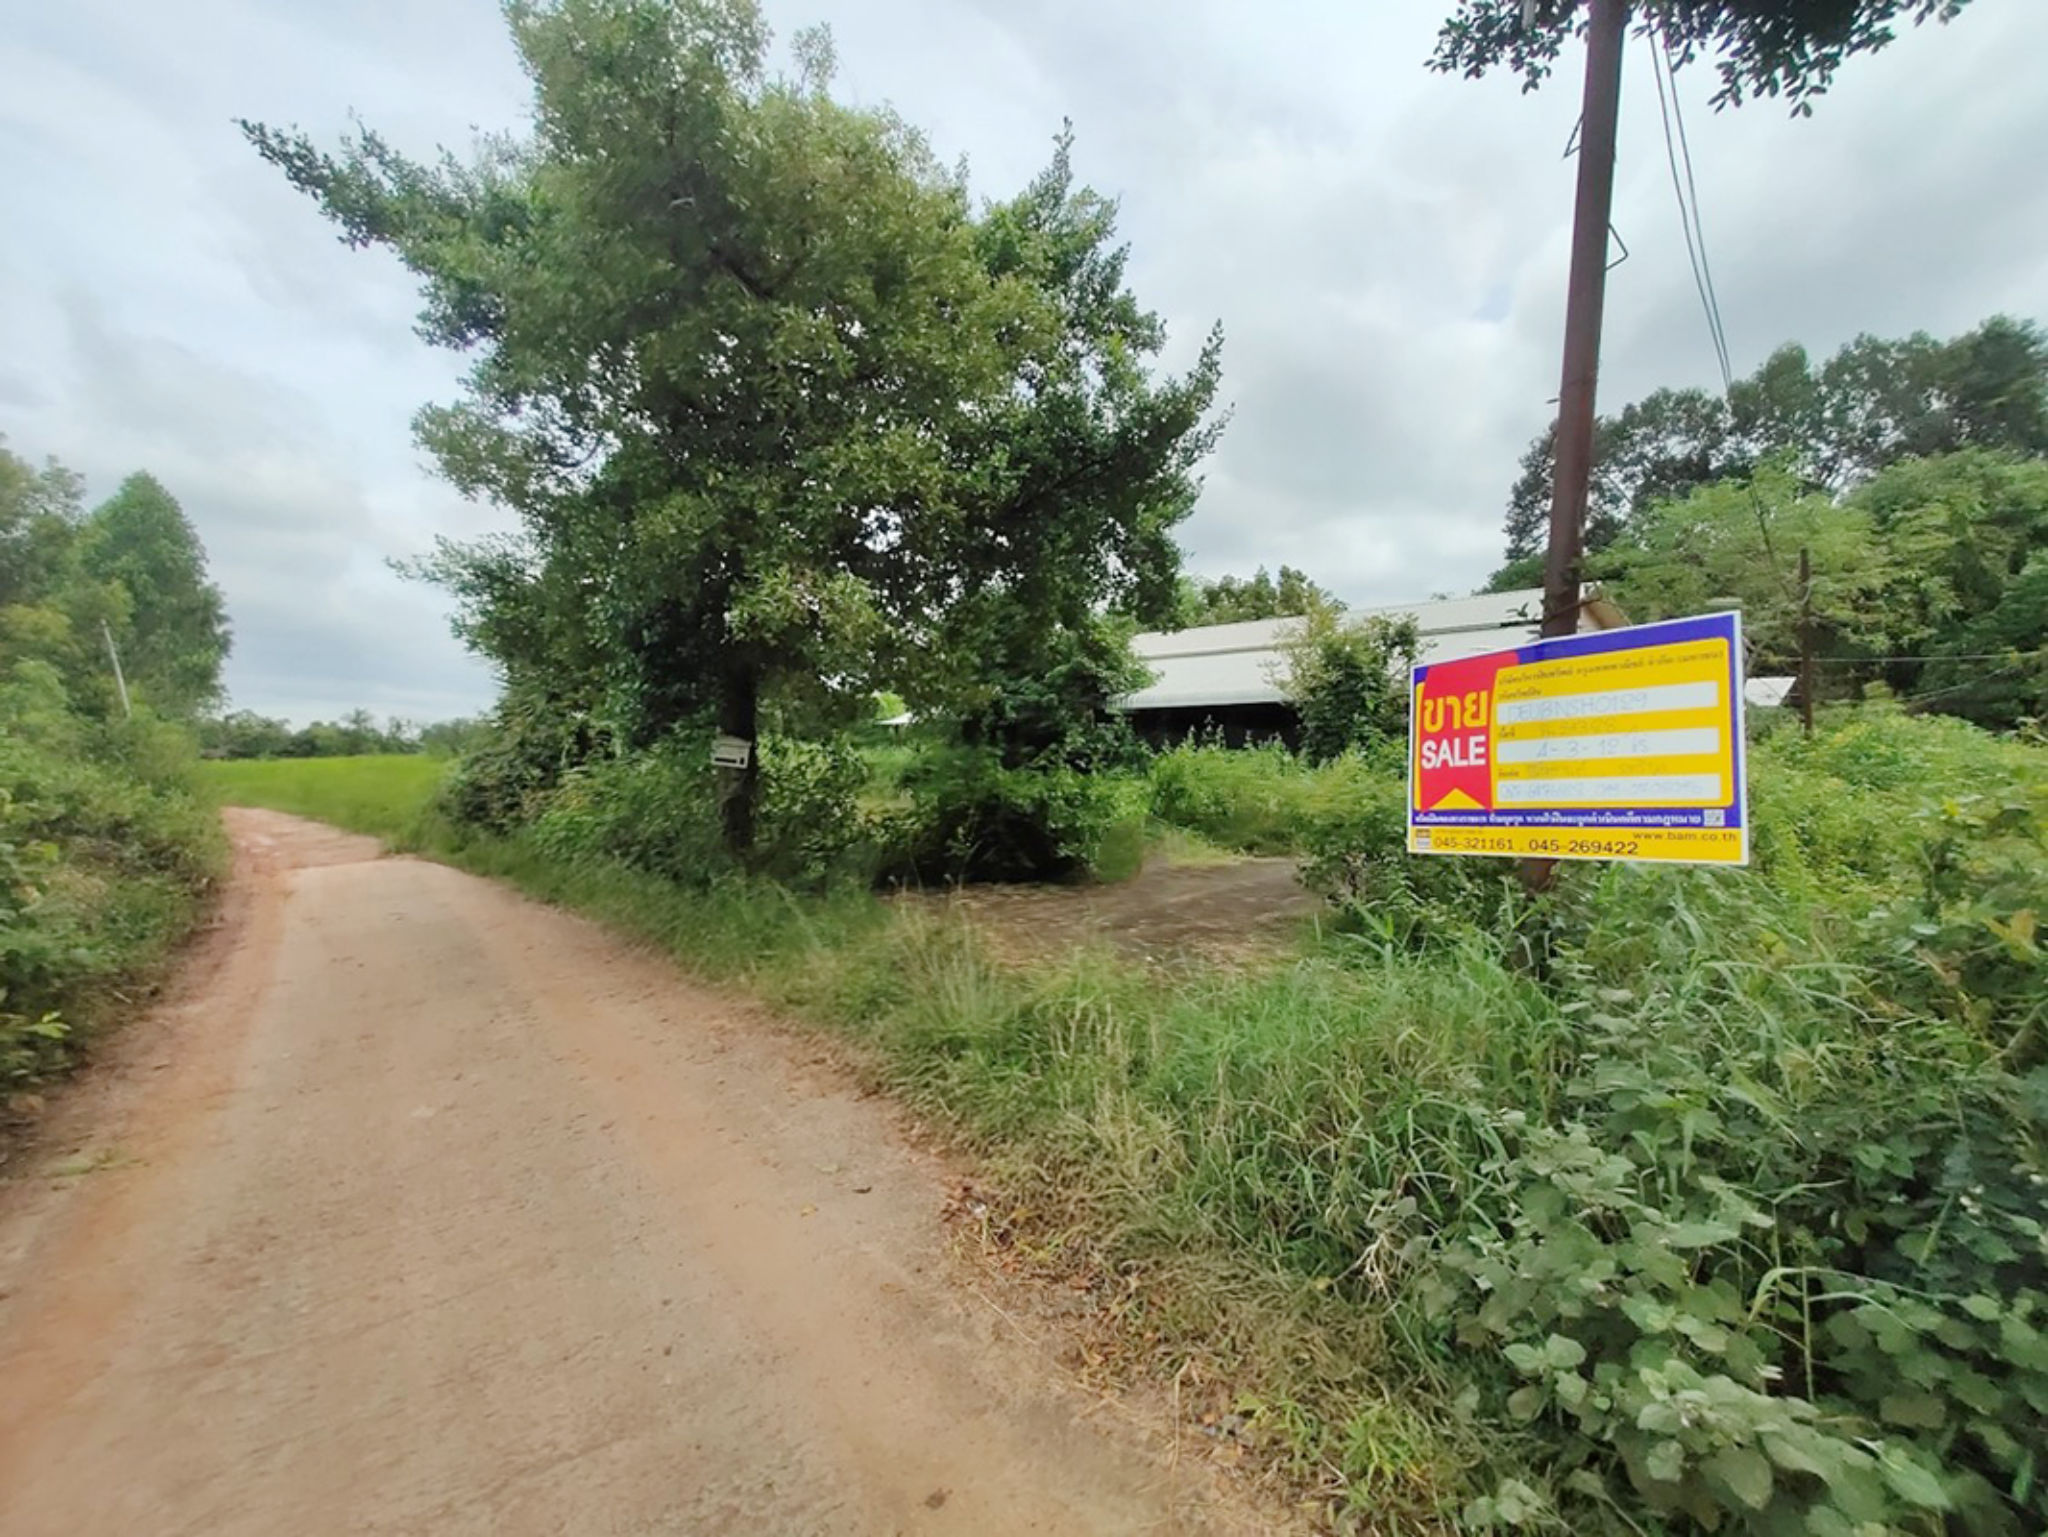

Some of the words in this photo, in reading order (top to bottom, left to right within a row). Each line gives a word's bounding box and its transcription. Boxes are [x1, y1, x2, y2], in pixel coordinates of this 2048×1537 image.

[1423, 690, 1488, 733] ขาย
[1421, 736, 1486, 769] SALE
[1434, 837, 1514, 850] 045-321161
[1529, 839, 1639, 855] 045-269422
